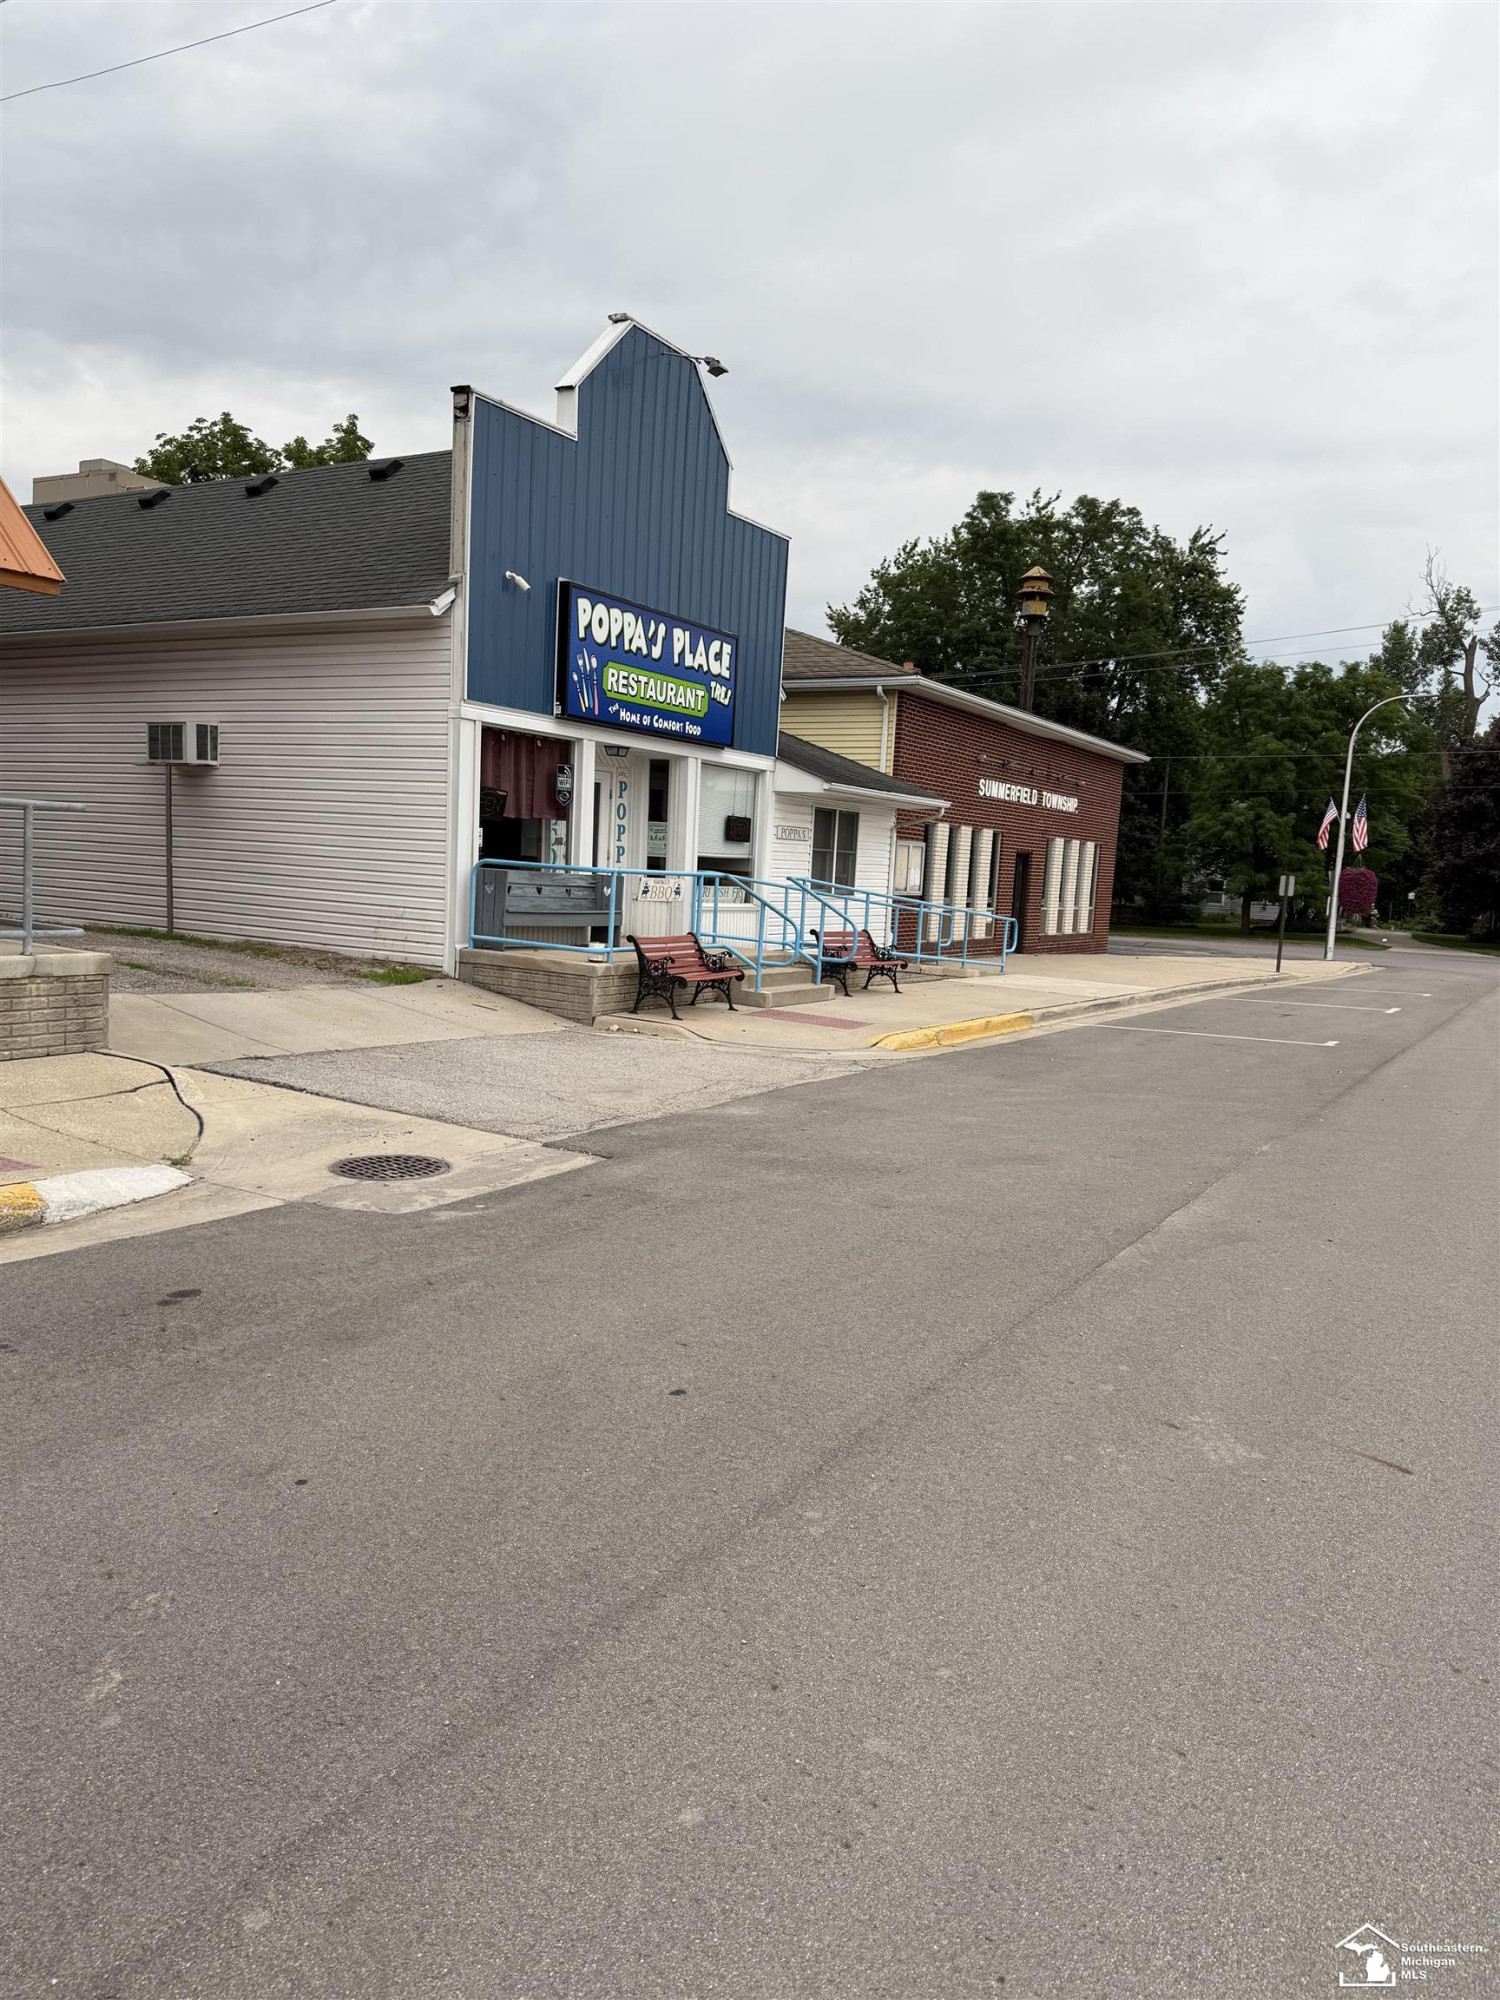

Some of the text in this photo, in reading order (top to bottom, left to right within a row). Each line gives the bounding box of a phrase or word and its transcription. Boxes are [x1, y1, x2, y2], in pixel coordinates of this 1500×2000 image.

[577, 598, 732, 680] POPPA'S PLACE
[607, 667, 705, 711] RESTAURANT
[710, 681, 732, 706] TRES
[608, 703, 702, 736] THE HOME OF COMFORT FOOD
[978, 779, 1038, 805] SUMMERFIELD
[616, 780, 628, 870] POPP
[649, 885, 673, 900] BBQ
